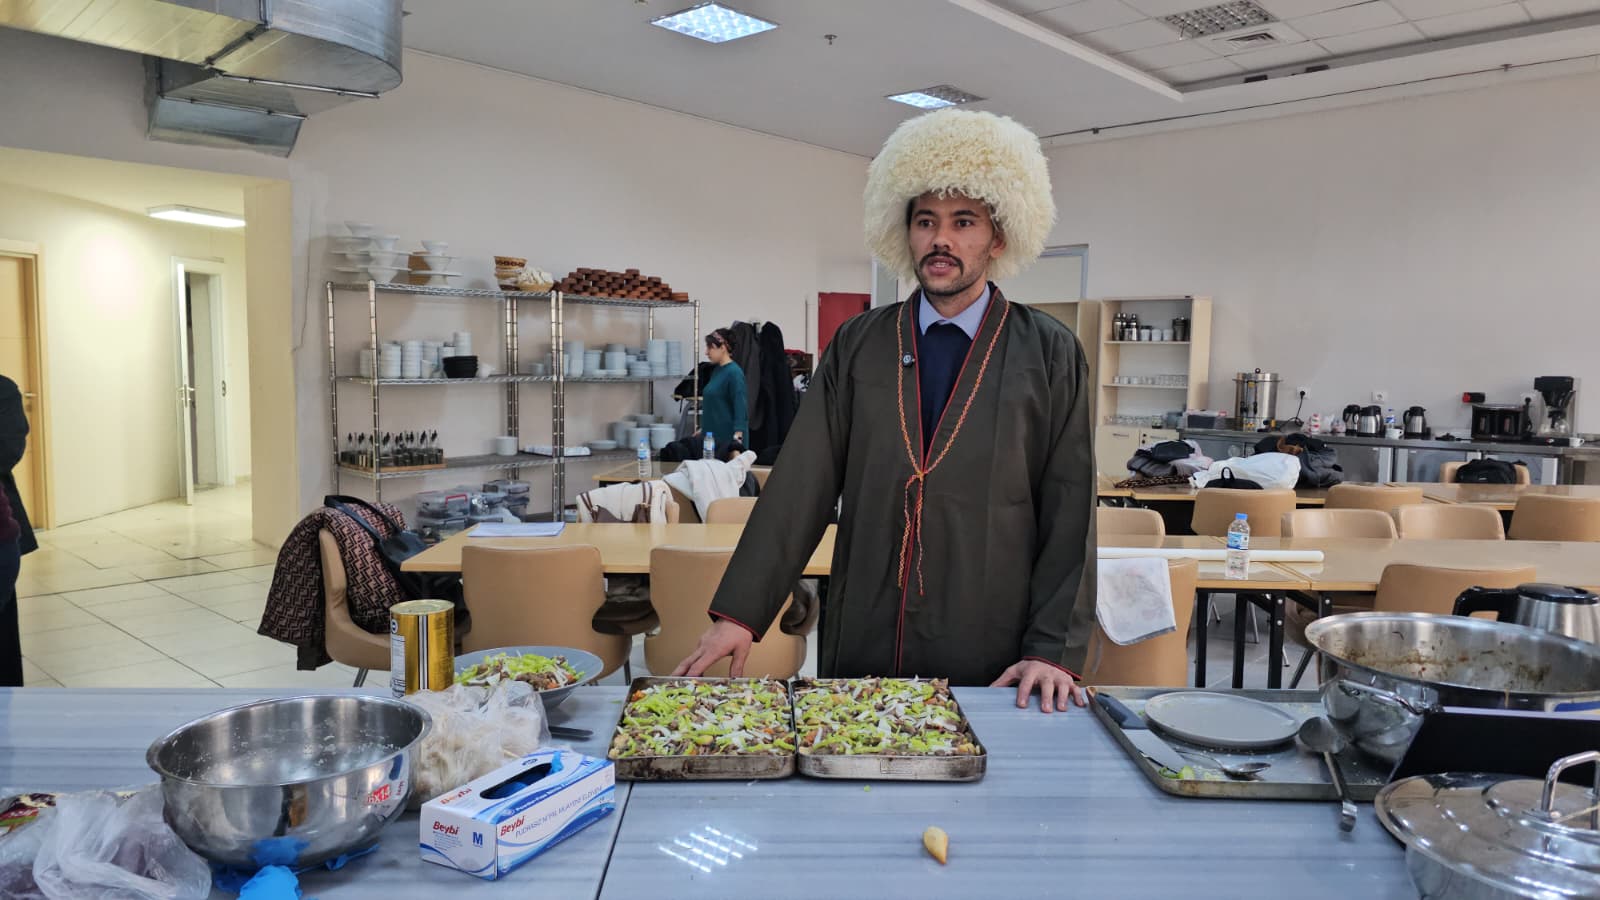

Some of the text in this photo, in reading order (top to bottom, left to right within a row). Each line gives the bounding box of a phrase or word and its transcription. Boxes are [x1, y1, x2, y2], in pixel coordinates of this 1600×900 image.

[432, 821, 460, 835] Beybi
[500, 815, 525, 837] Beybi
[472, 831, 483, 846] M
